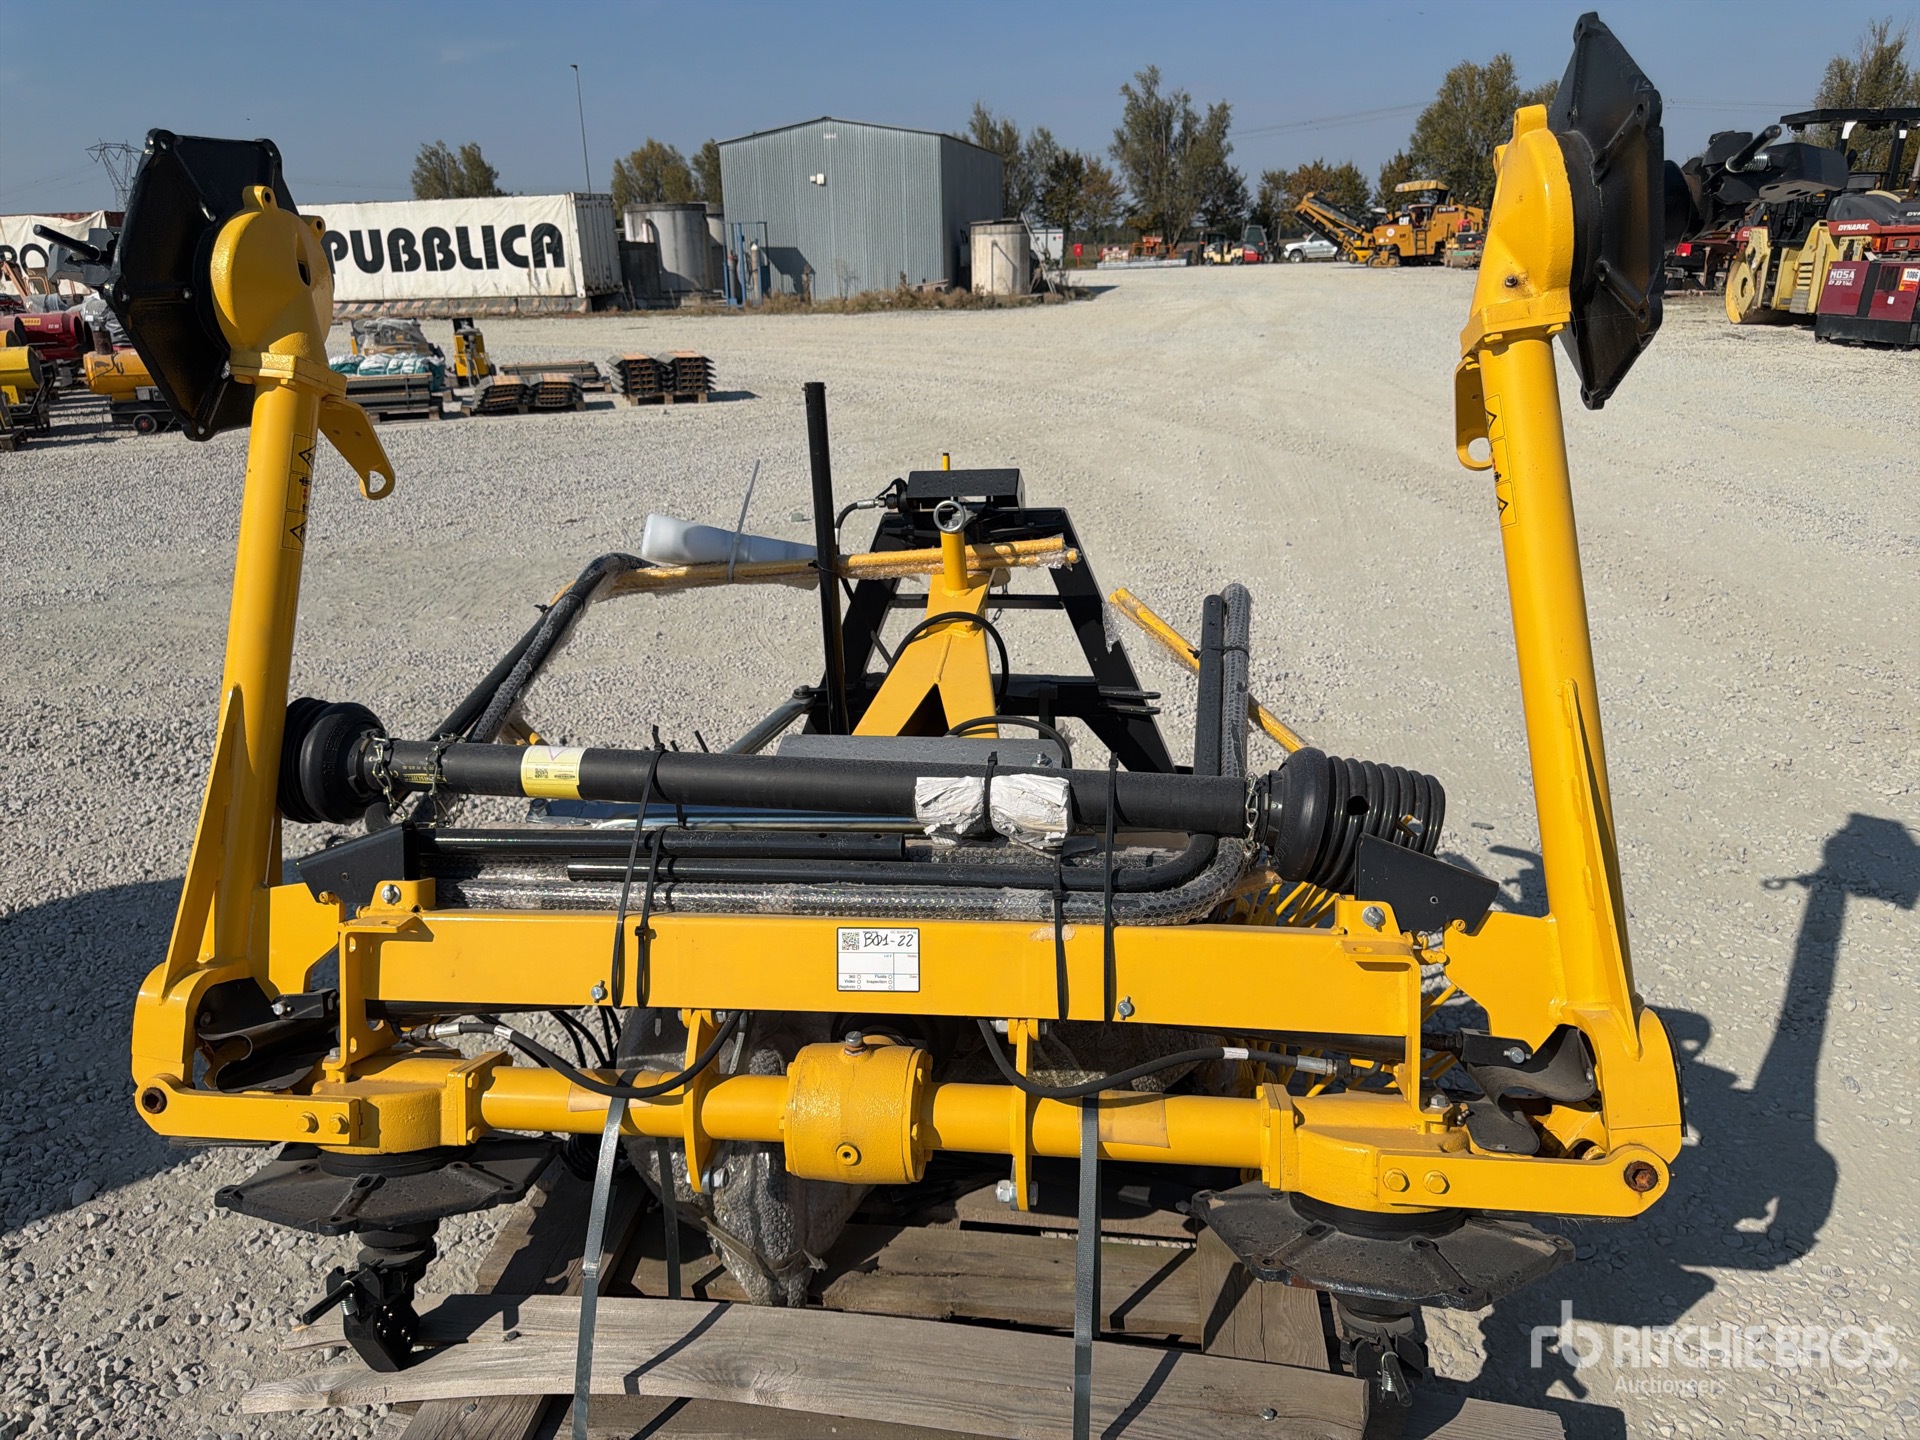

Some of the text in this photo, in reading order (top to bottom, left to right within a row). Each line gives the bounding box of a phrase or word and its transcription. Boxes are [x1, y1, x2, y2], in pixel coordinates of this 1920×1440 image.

[1838, 223, 1870, 231] DYNAPAC
[321, 223, 565, 274] PUBBLICA
[1830, 270, 1855, 279] MOSA
